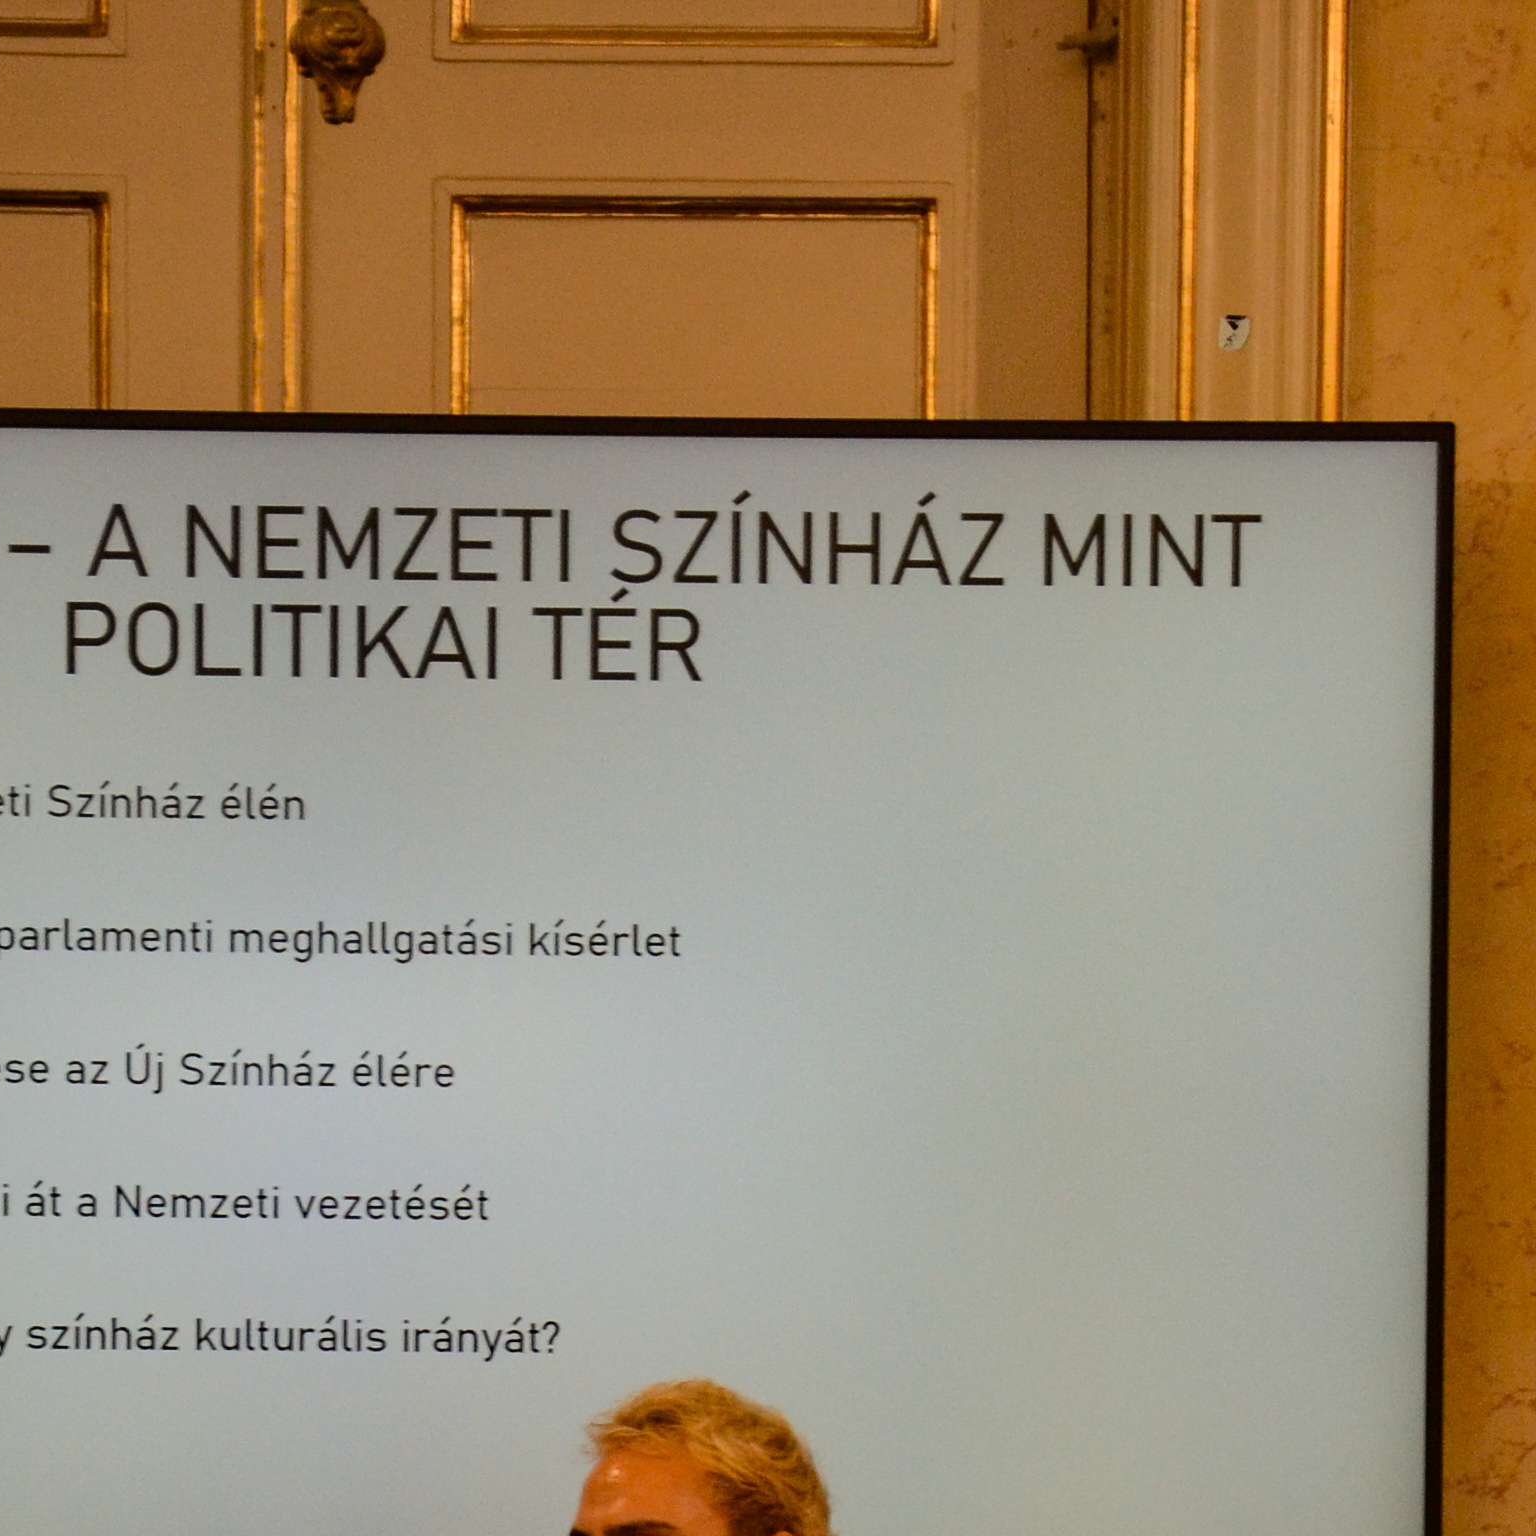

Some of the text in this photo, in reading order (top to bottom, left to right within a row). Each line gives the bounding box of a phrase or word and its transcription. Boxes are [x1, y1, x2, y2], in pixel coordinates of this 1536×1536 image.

[86, 502, 149, 578] A
[185, 504, 571, 583] NEMZETI
[610, 489, 1006, 588] SZÍNHÁZ
[1042, 512, 1264, 588] MINT
[65, 586, 703, 683] POLITIKAI TÉR
[47, 780, 206, 820] Színház
[220, 782, 306, 821] élén
[229, 918, 513, 965] meghallgatási
[528, 918, 682, 958] kísérlet
[65, 1059, 110, 1086] az
[125, 1042, 164, 1096] Új
[179, 1048, 337, 1088] Színház
[351, 1050, 456, 1089] élére
[24, 1179, 62, 1218] át
[76, 1192, 98, 1218] a
[114, 1184, 280, 1220] Nemzeti
[294, 1183, 489, 1222] vezetését
[26, 1312, 180, 1352] színház
[195, 1314, 388, 1353] kulturális
[402, 1315, 561, 1363] irányát?
